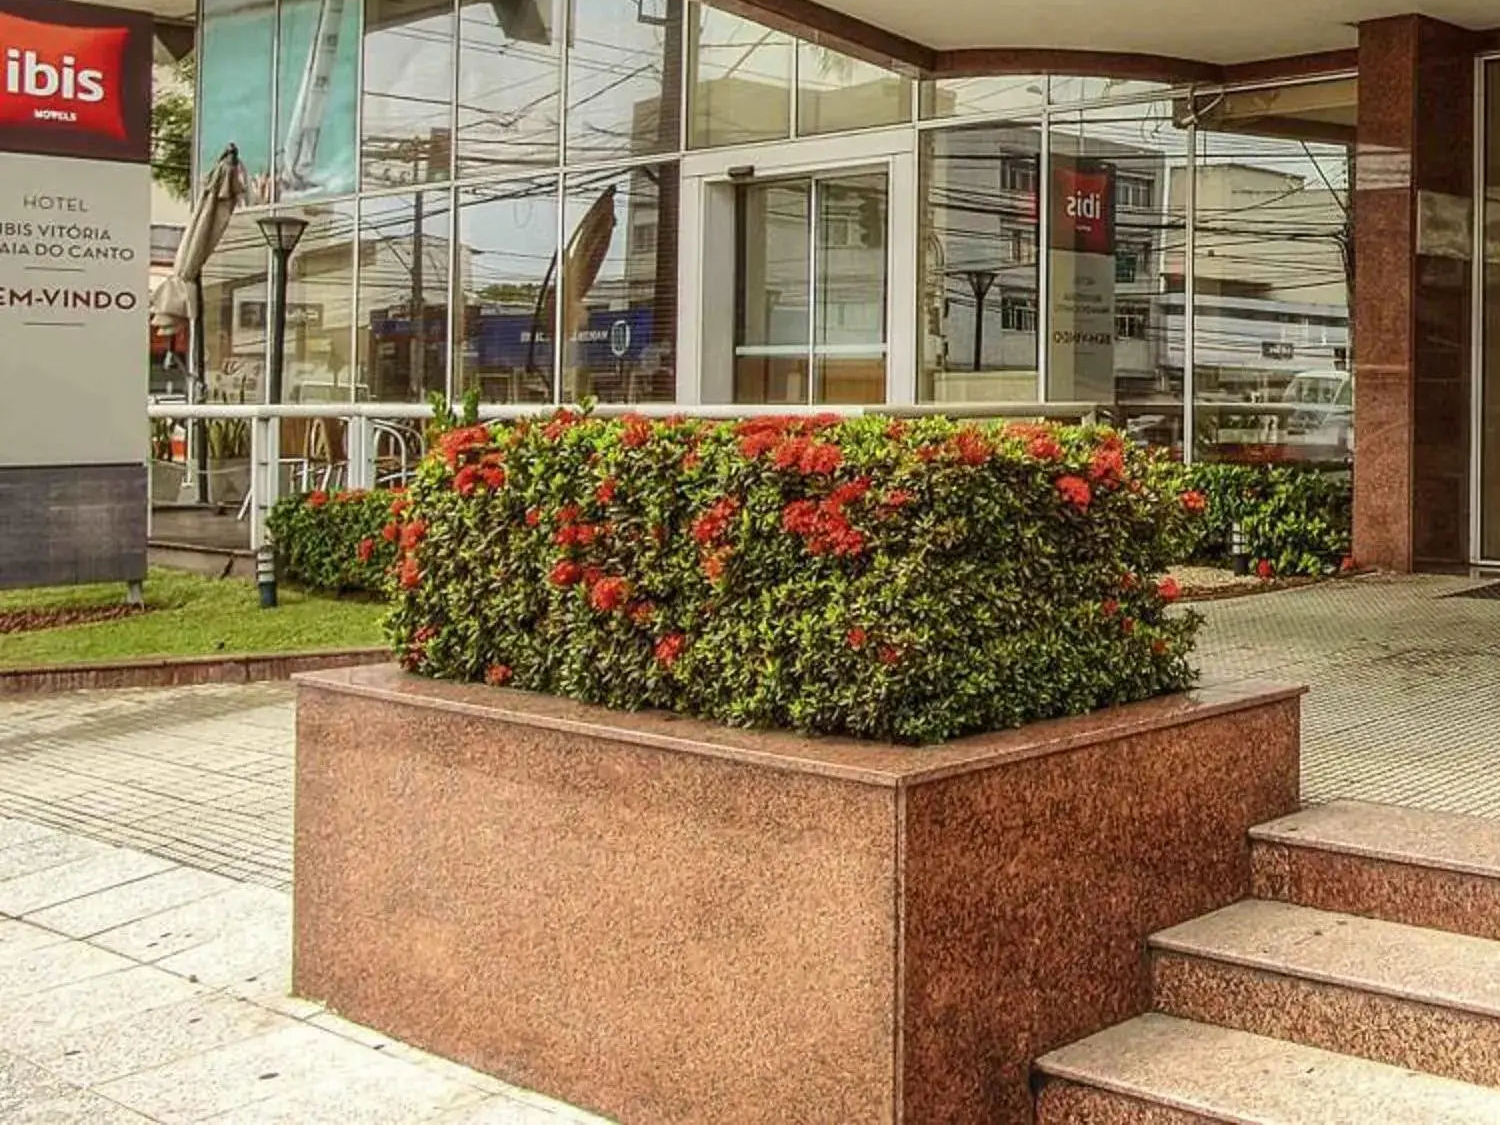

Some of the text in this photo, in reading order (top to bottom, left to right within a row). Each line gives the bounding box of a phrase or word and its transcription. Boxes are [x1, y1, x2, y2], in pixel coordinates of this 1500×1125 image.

[7, 48, 104, 102] ibis
[23, 195, 88, 212] HOTEL
[38, 224, 111, 240] VITÓRIA
[35, 243, 64, 257] DO
[68, 245, 134, 261] CANTO
